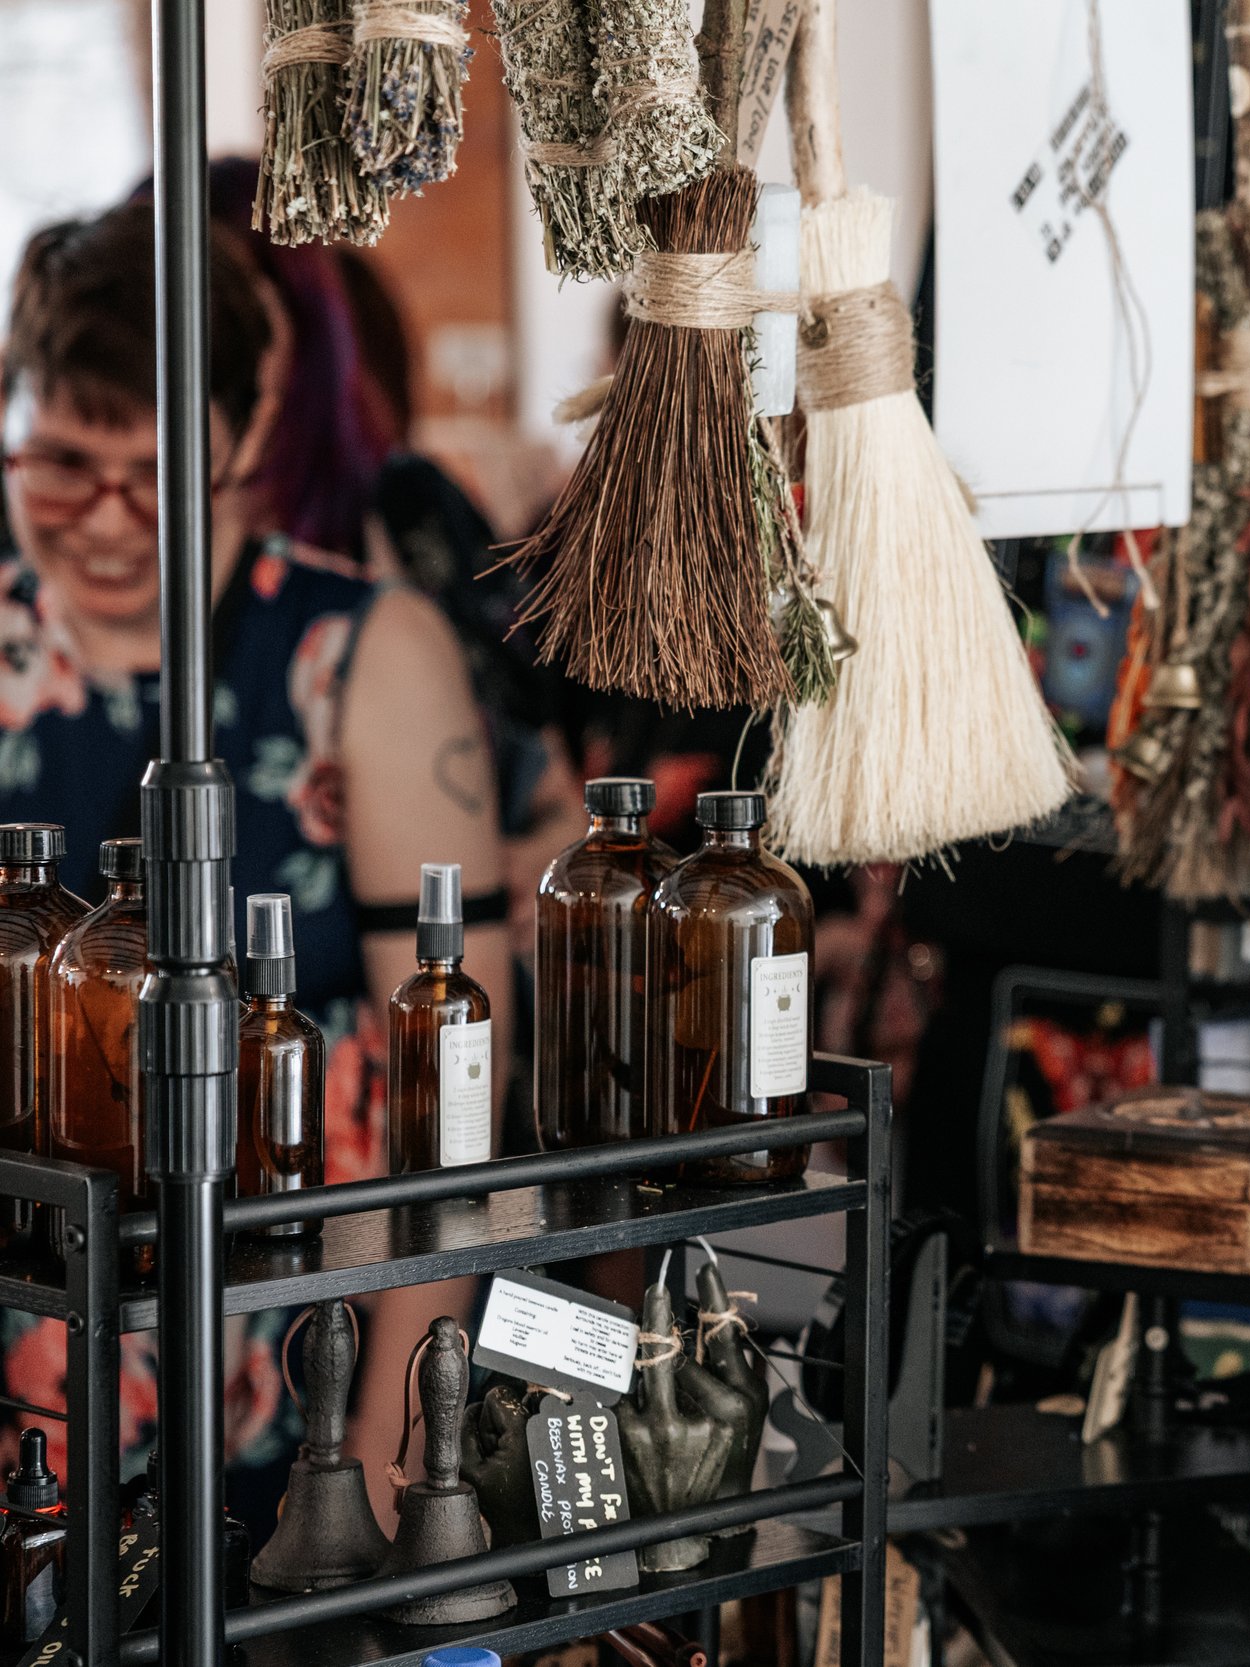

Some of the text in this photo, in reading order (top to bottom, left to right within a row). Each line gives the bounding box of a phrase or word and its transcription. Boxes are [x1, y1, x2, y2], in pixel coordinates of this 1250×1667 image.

[548, 1417, 567, 1485] BEESWAX
[567, 1415, 587, 1464] WITH
[535, 1460, 554, 1524] CANDLE
